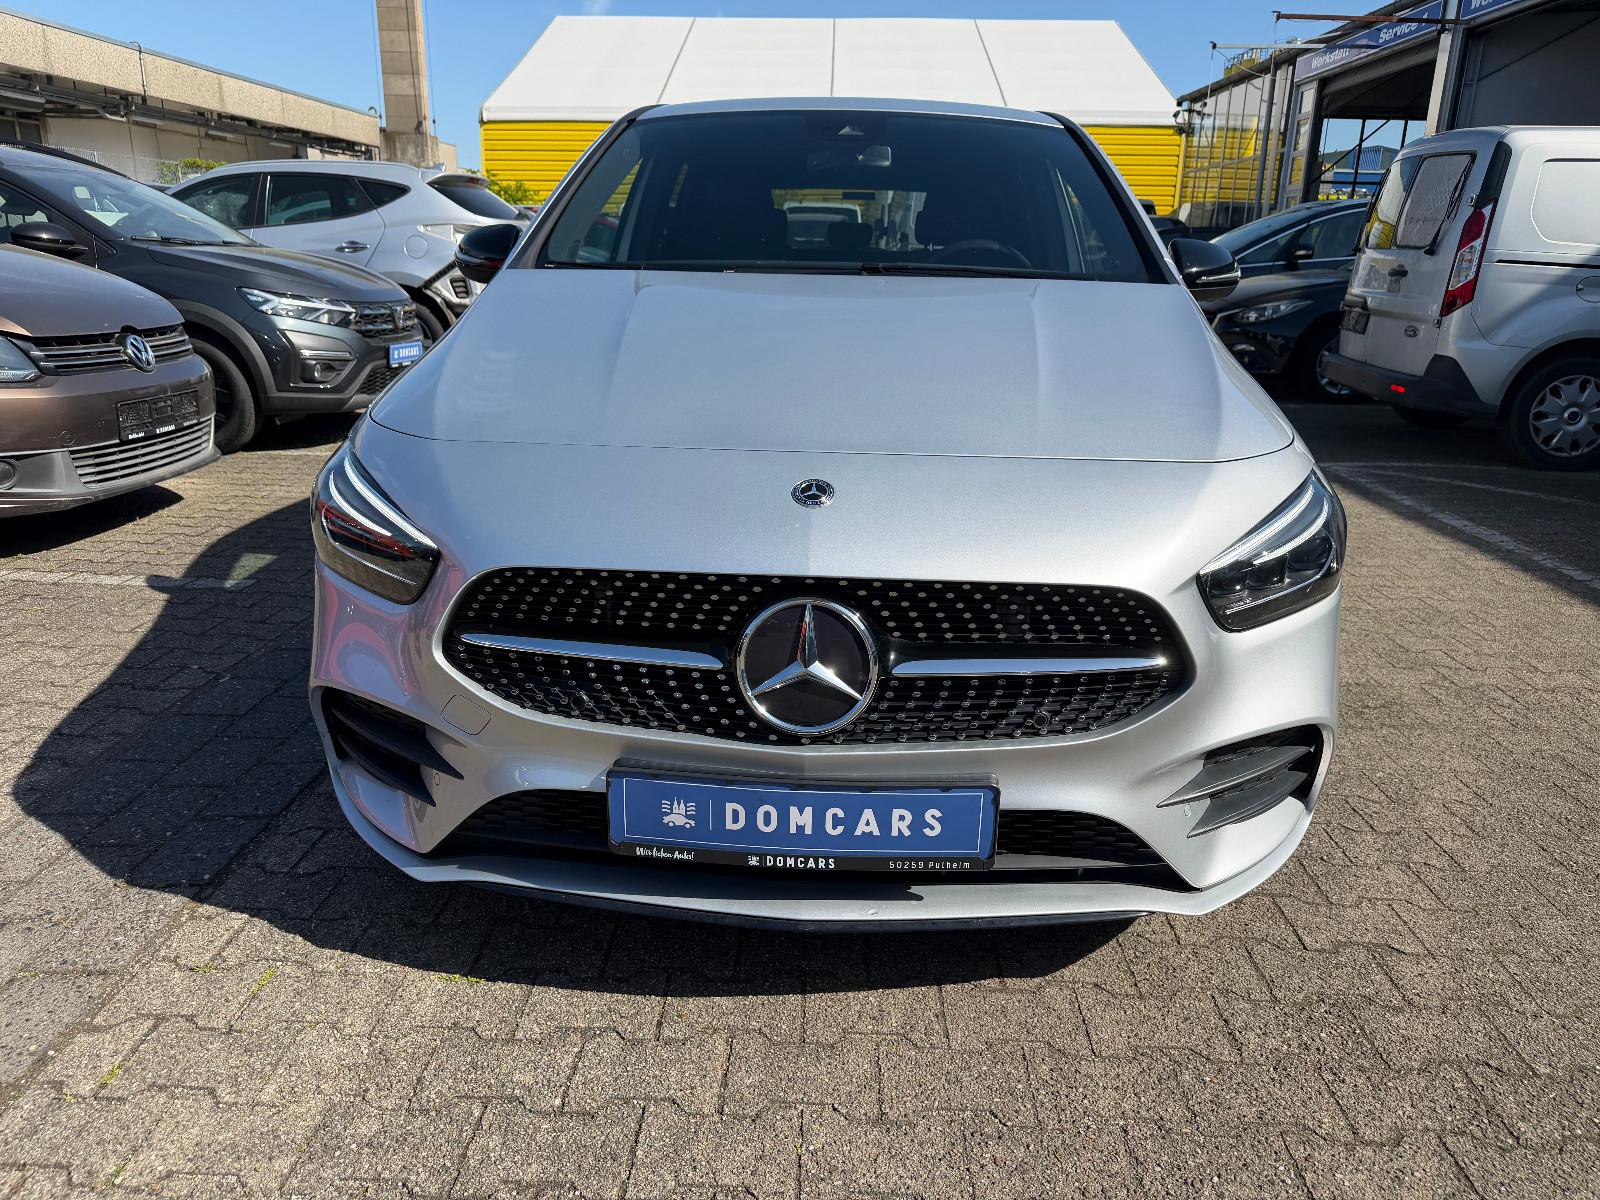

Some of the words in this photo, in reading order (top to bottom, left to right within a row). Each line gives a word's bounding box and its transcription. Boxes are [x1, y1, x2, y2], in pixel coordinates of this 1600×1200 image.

[725, 802, 943, 837] DOMCARS
[635, 846, 653, 856] Wir
[673, 850, 695, 860] Autos!
[766, 855, 835, 869] DOMCARS
[889, 860, 924, 869] 50259
